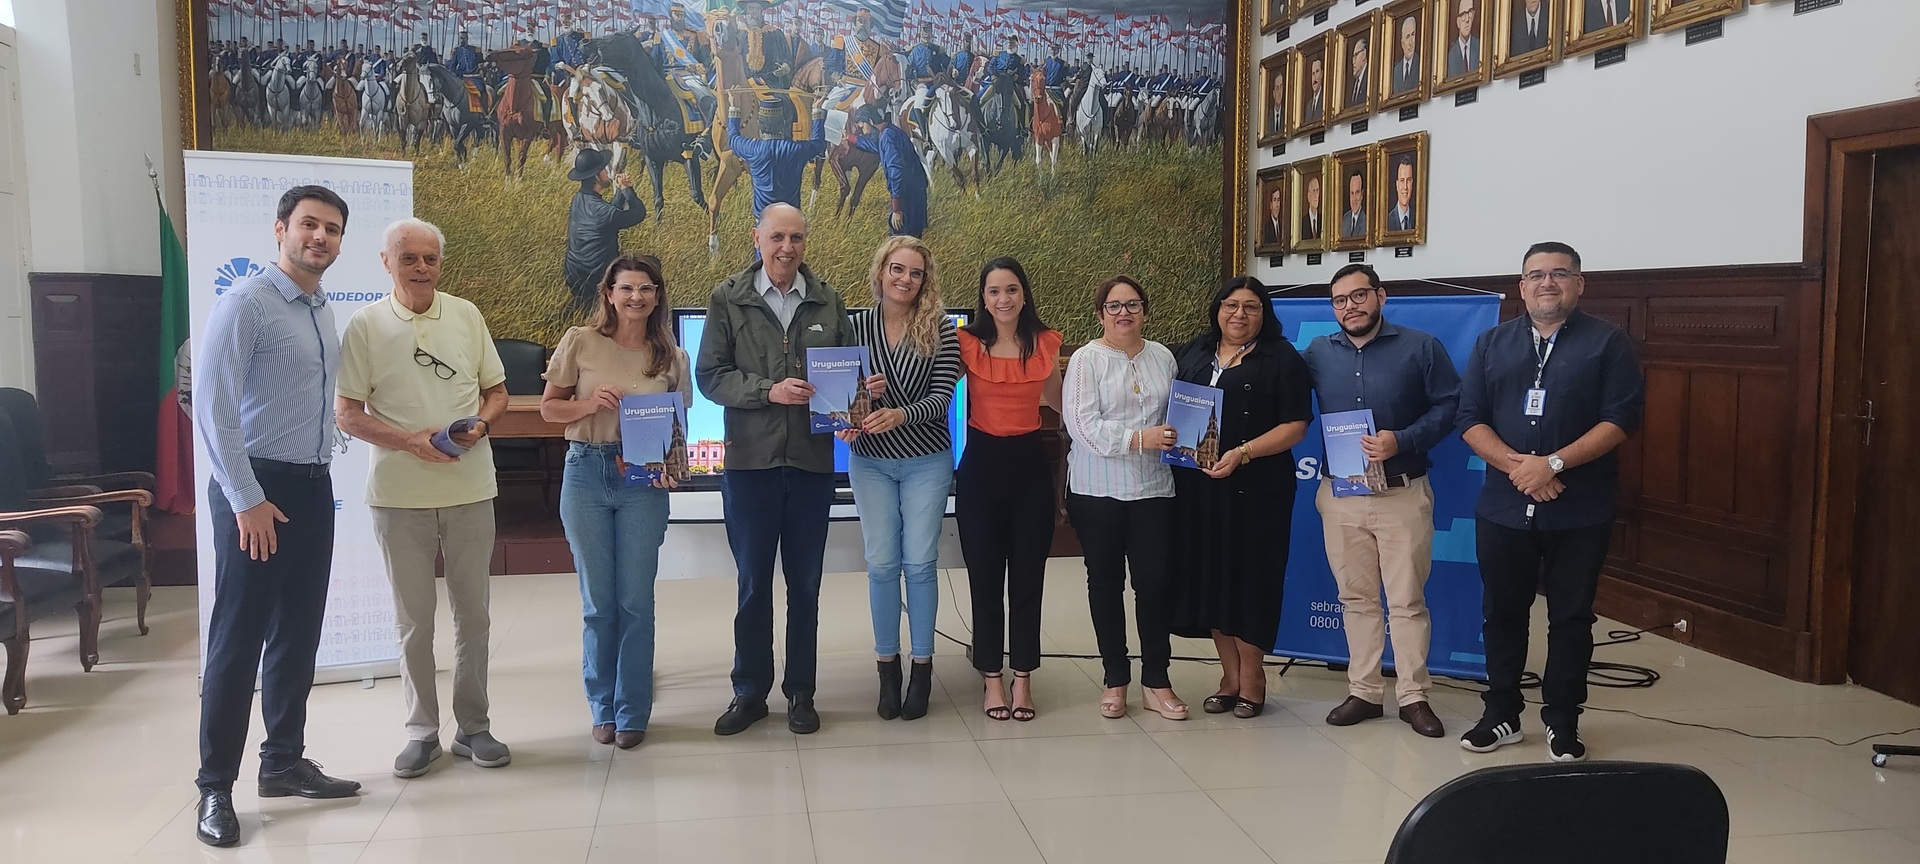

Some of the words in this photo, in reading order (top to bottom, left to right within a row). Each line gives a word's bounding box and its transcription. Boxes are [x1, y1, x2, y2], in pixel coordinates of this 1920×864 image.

[811, 359, 861, 370] Uruguaiana
[1174, 392, 1215, 407] Uruguaiana
[624, 405, 675, 417] Uruguaiana
[1326, 422, 1368, 433] Uruguaiana
[1309, 615, 1340, 630] 0800
